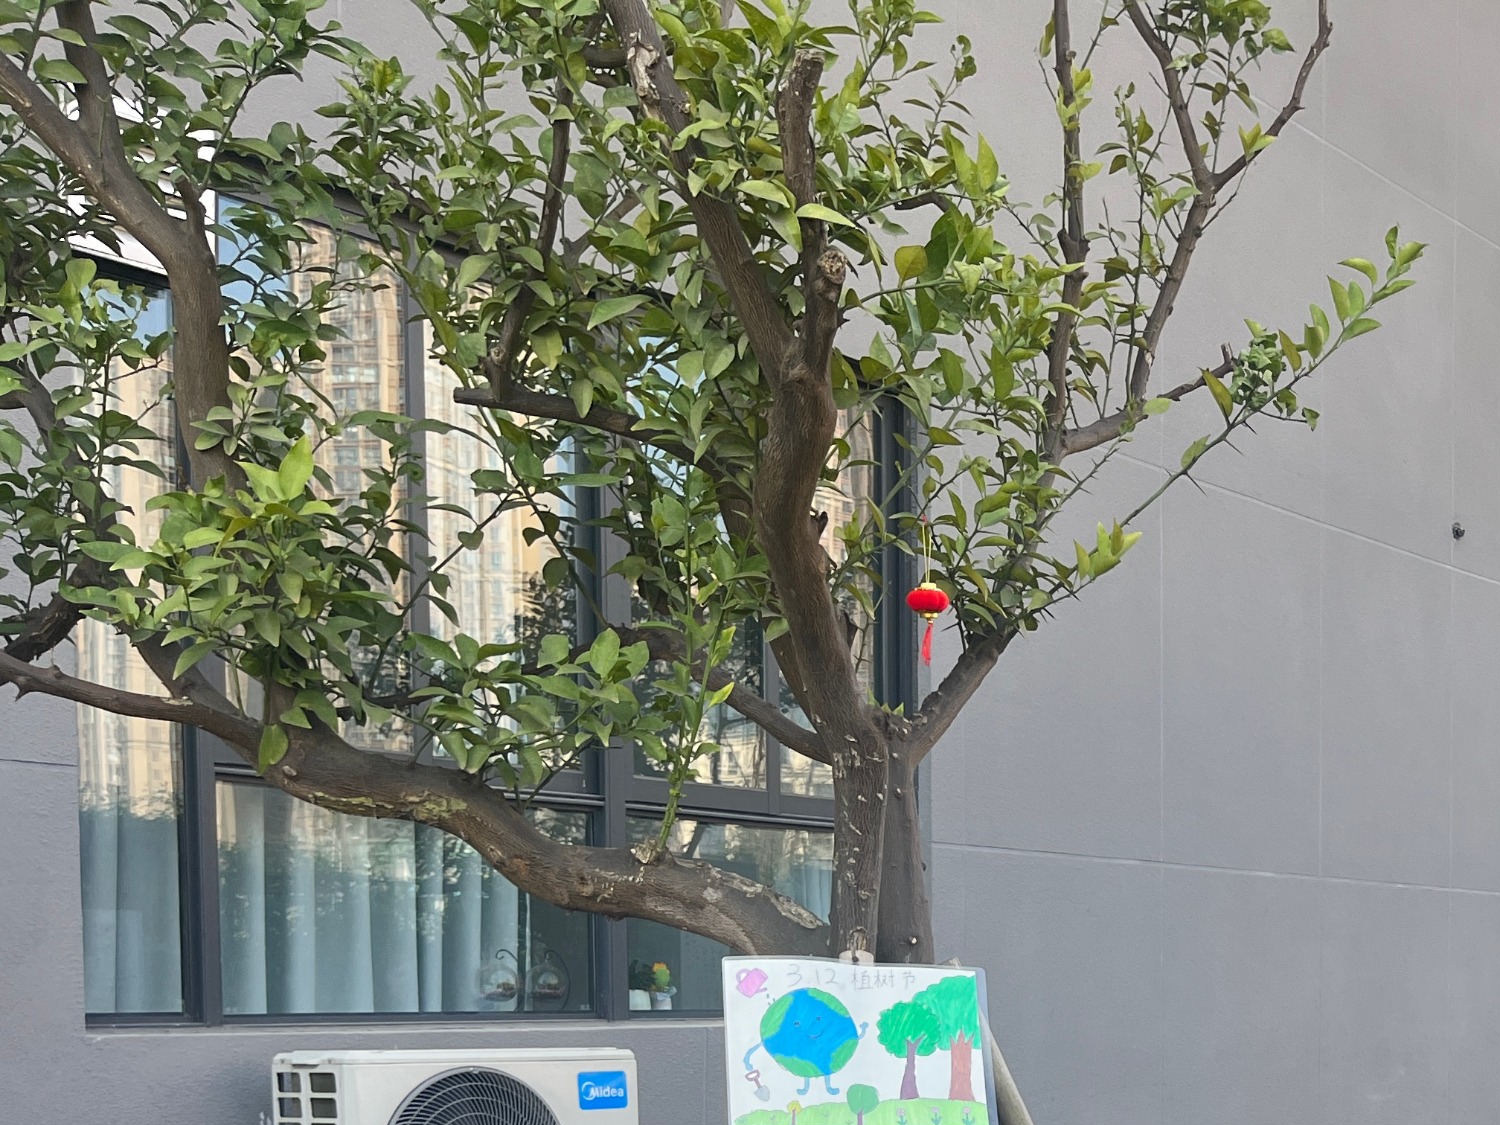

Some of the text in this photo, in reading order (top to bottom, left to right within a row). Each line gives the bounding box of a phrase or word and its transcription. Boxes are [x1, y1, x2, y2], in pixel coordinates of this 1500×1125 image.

[851, 968, 916, 991] 植树节
[585, 1084, 624, 1099] Midea
